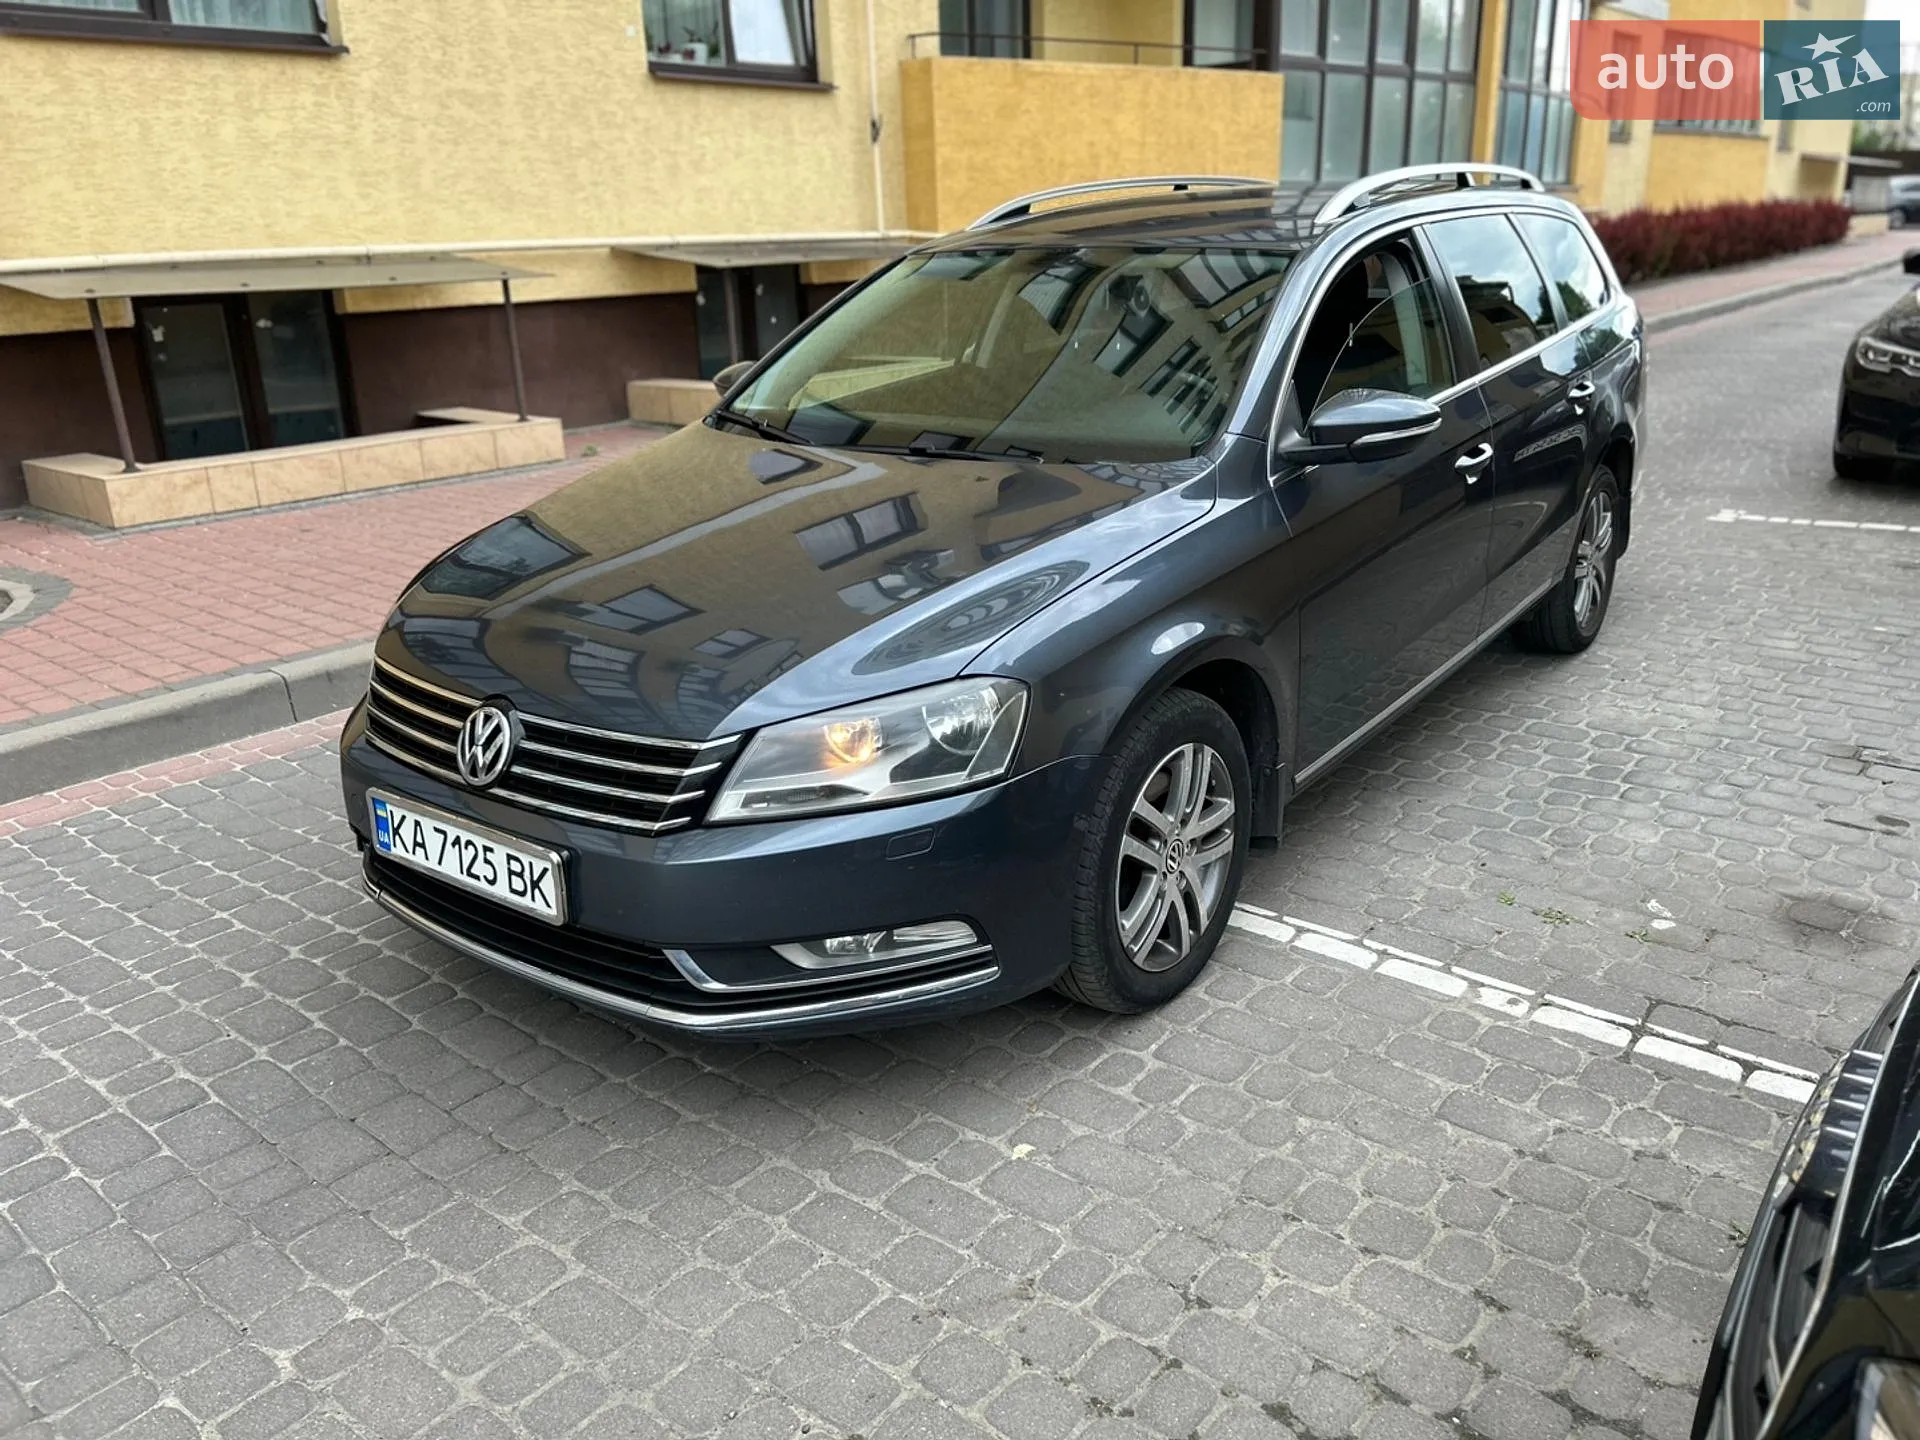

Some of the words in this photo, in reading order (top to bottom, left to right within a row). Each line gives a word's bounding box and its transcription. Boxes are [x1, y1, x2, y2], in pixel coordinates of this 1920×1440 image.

[378, 829, 390, 845] UA
[389, 809, 429, 861] KA
[433, 826, 498, 886] 7125
[506, 852, 552, 909] BK
